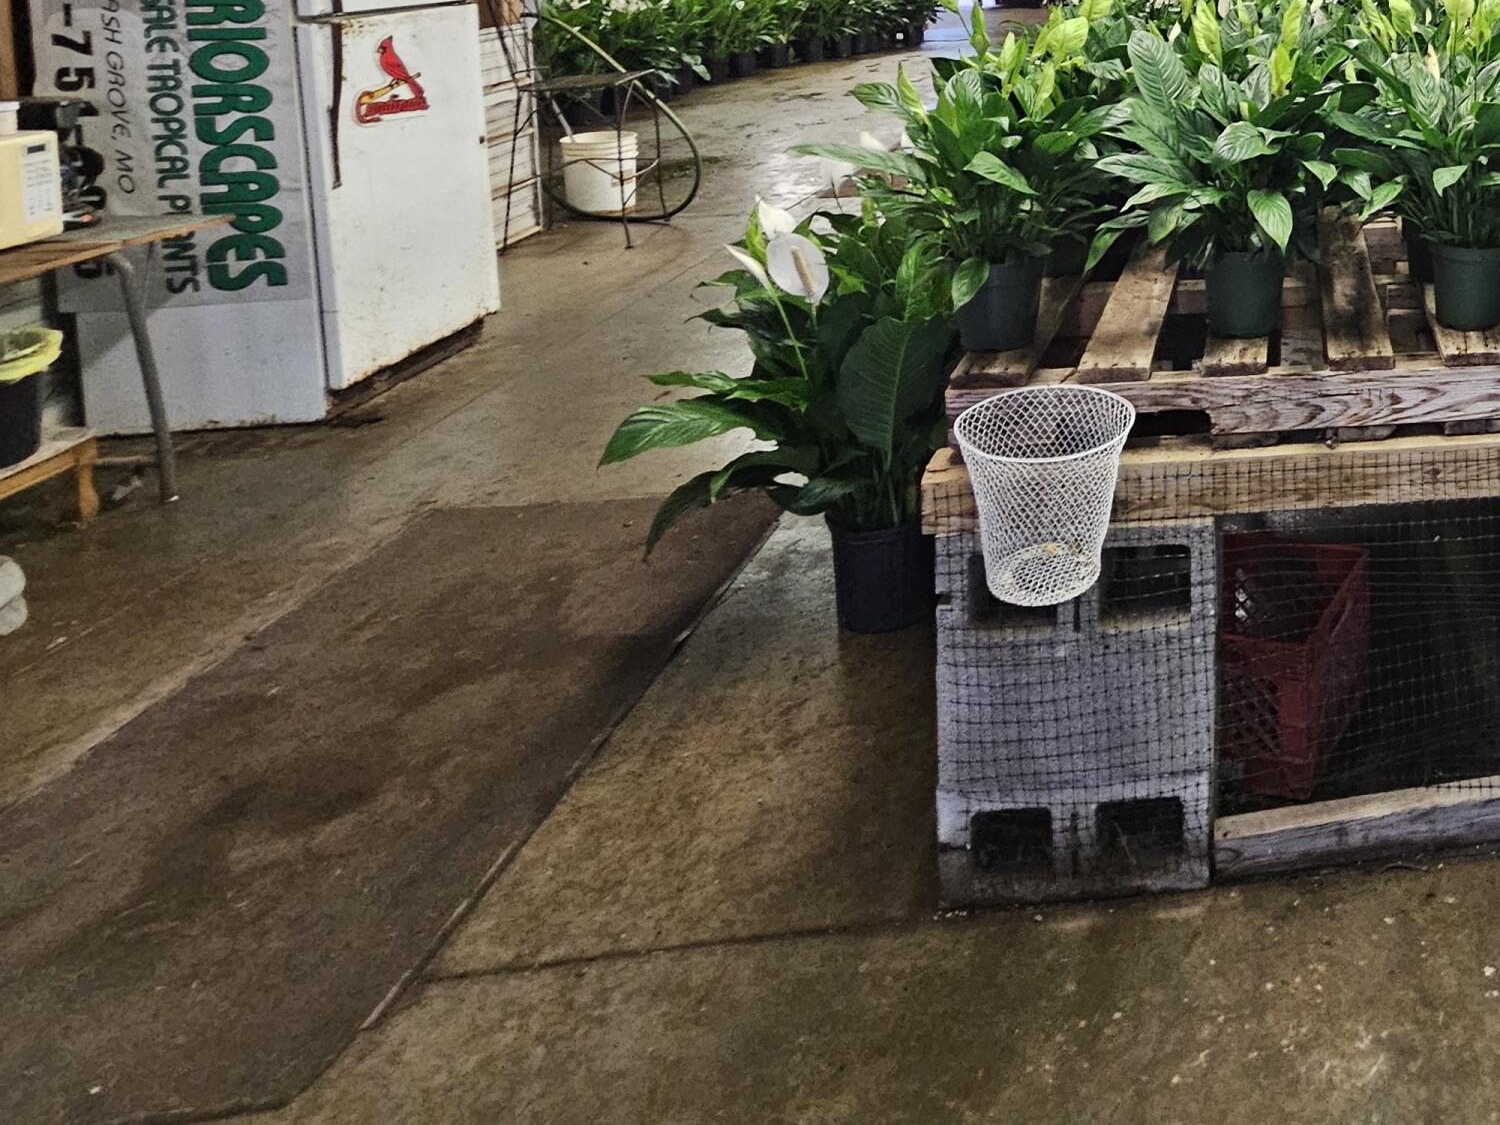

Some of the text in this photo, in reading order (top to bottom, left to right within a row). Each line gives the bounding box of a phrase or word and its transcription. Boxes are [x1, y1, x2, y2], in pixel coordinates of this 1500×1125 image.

[105, 50, 132, 141] GROVE,
[146, 58, 191, 189] TROPICAL
[115, 148, 136, 195] MO
[157, 194, 201, 294] PNTS
